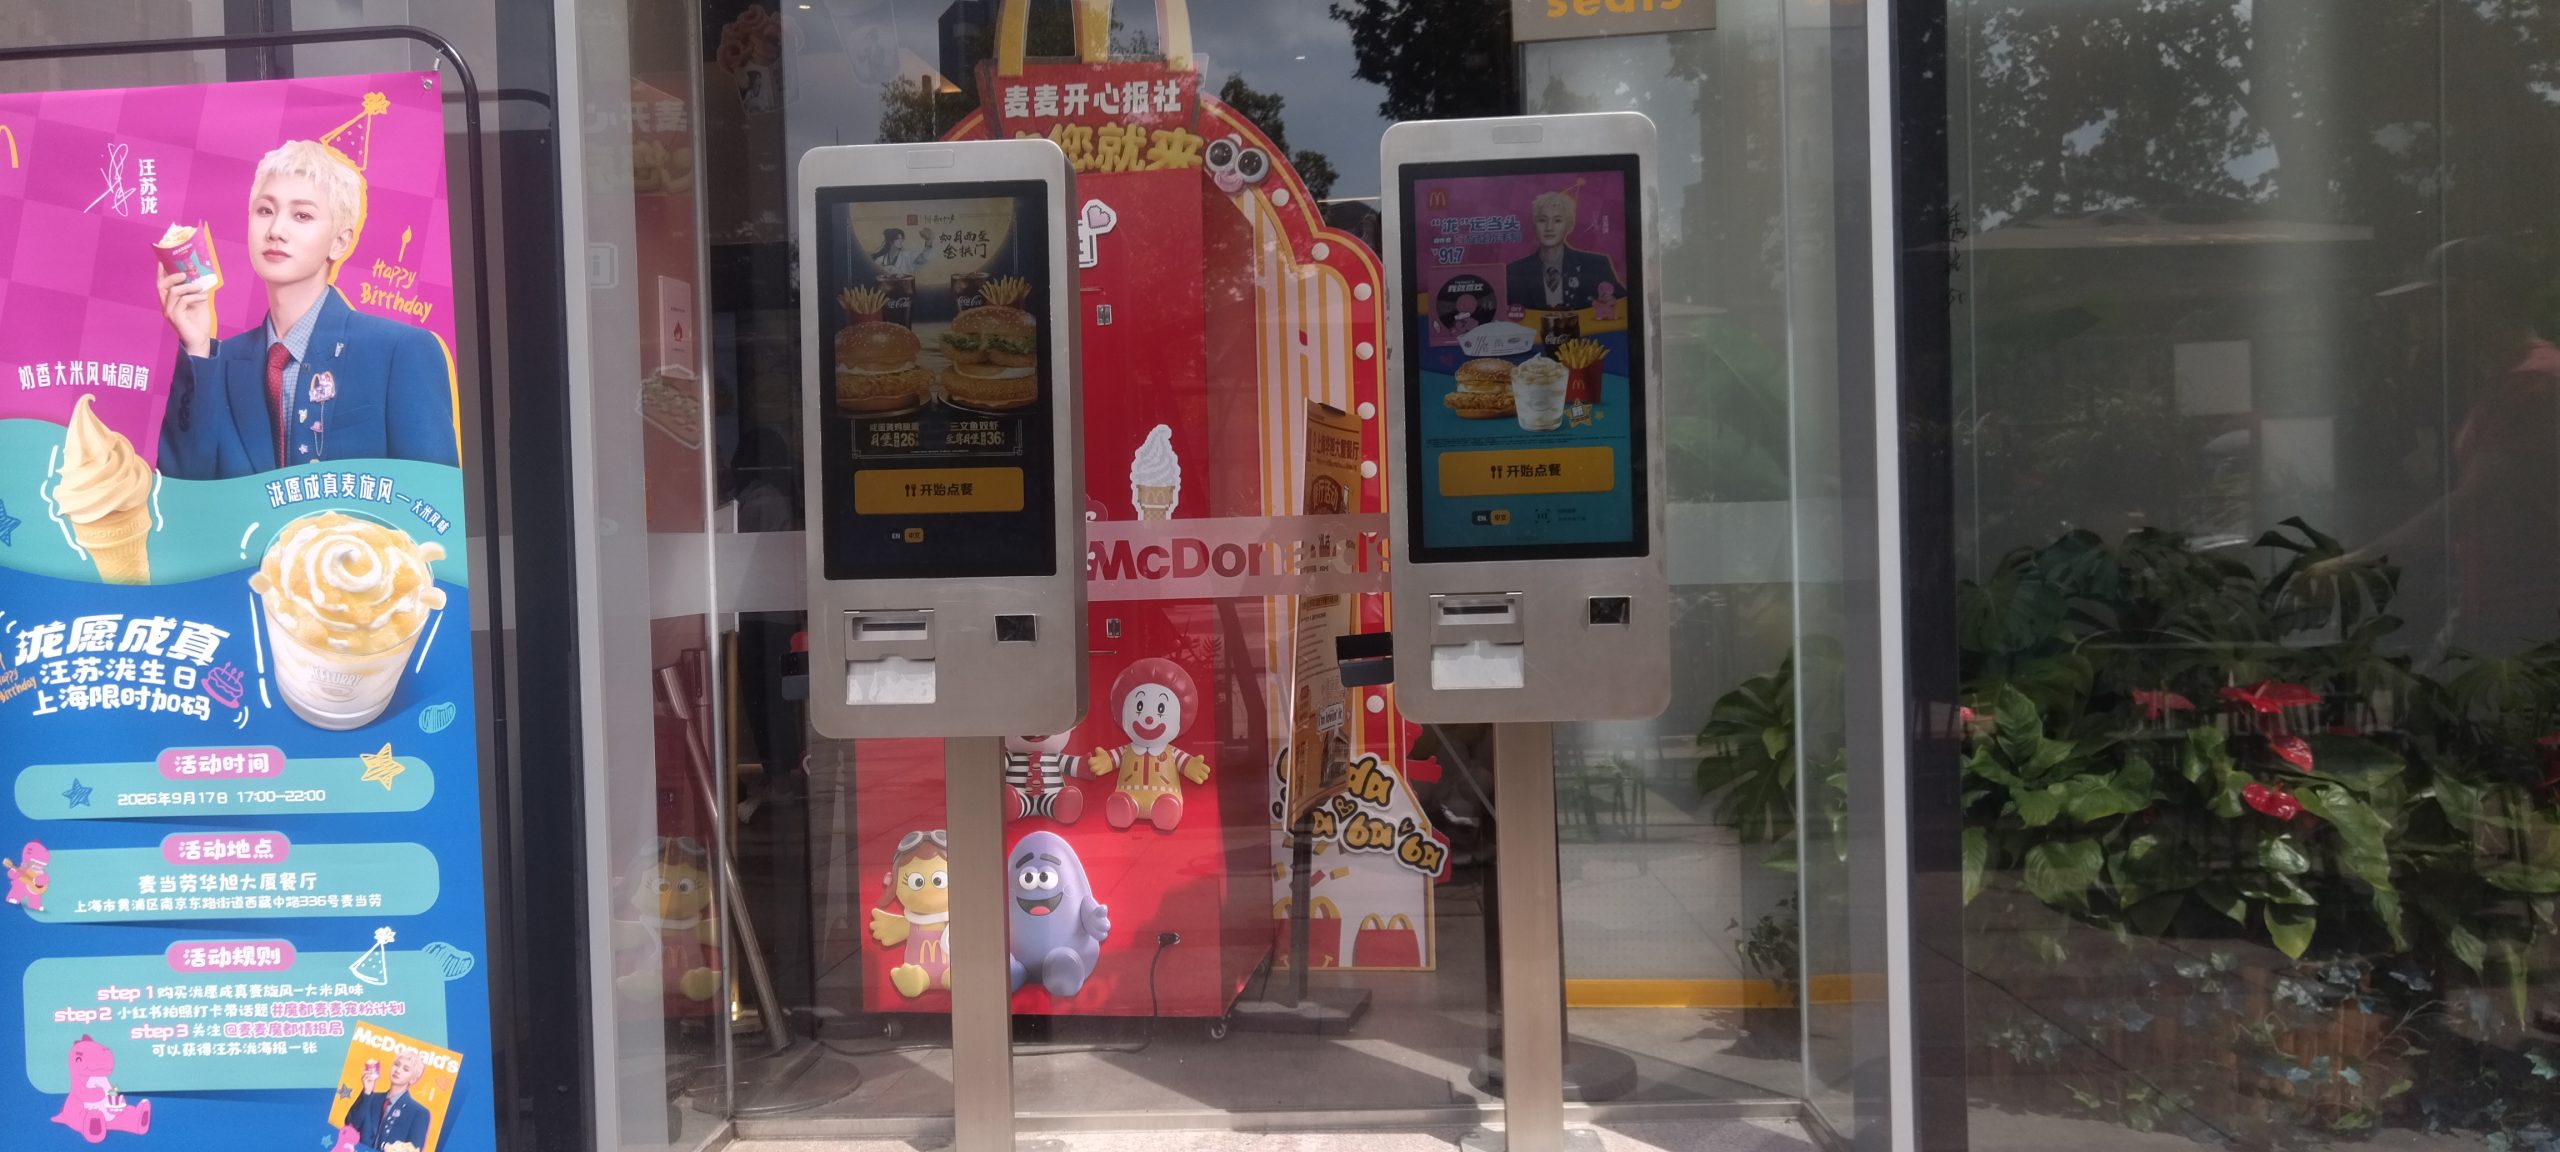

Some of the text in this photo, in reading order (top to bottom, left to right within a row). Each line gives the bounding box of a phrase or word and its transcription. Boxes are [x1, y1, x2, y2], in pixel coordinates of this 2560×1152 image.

[1004, 79, 1182, 118] 麦麦开心报社
[1016, 122, 1204, 173] 您就来
[139, 158, 158, 214] 汪苏泷
[939, 230, 990, 244] 如月而至
[943, 243, 988, 259] 金拱门
[372, 258, 417, 289] Happy
[360, 282, 433, 323] Birthday
[18, 360, 150, 392] 奶香大米风味圆筒
[1506, 464, 1561, 479] 开始点餐
[920, 482, 973, 497] 开始点餐
[0, 669, 19, 686] appy
[40, 658, 196, 690] 汪苏泷生日
[32, 685, 211, 721] 上海限时加码
[174, 753, 270, 774] 活动时间
[117, 791, 228, 806] 2026年9月17日
[178, 838, 275, 860] 活动地点
[138, 872, 317, 894] 麦当劳华旭大厦餐厅
[74, 893, 382, 913] 上海市黄浦区南京东路街道西藏中路336号麦当劳
[183, 946, 281, 968] 活动规则
[117, 1003, 268, 1021] 小红书拍照打卡带话题
[271, 1001, 405, 1018] #魔都麦麦宠粉计划
[193, 1023, 222, 1037] 关注
[224, 1021, 344, 1038] @麦麦魔都情报局
[152, 1041, 318, 1057] 可以获得汪苏泷海报一张
